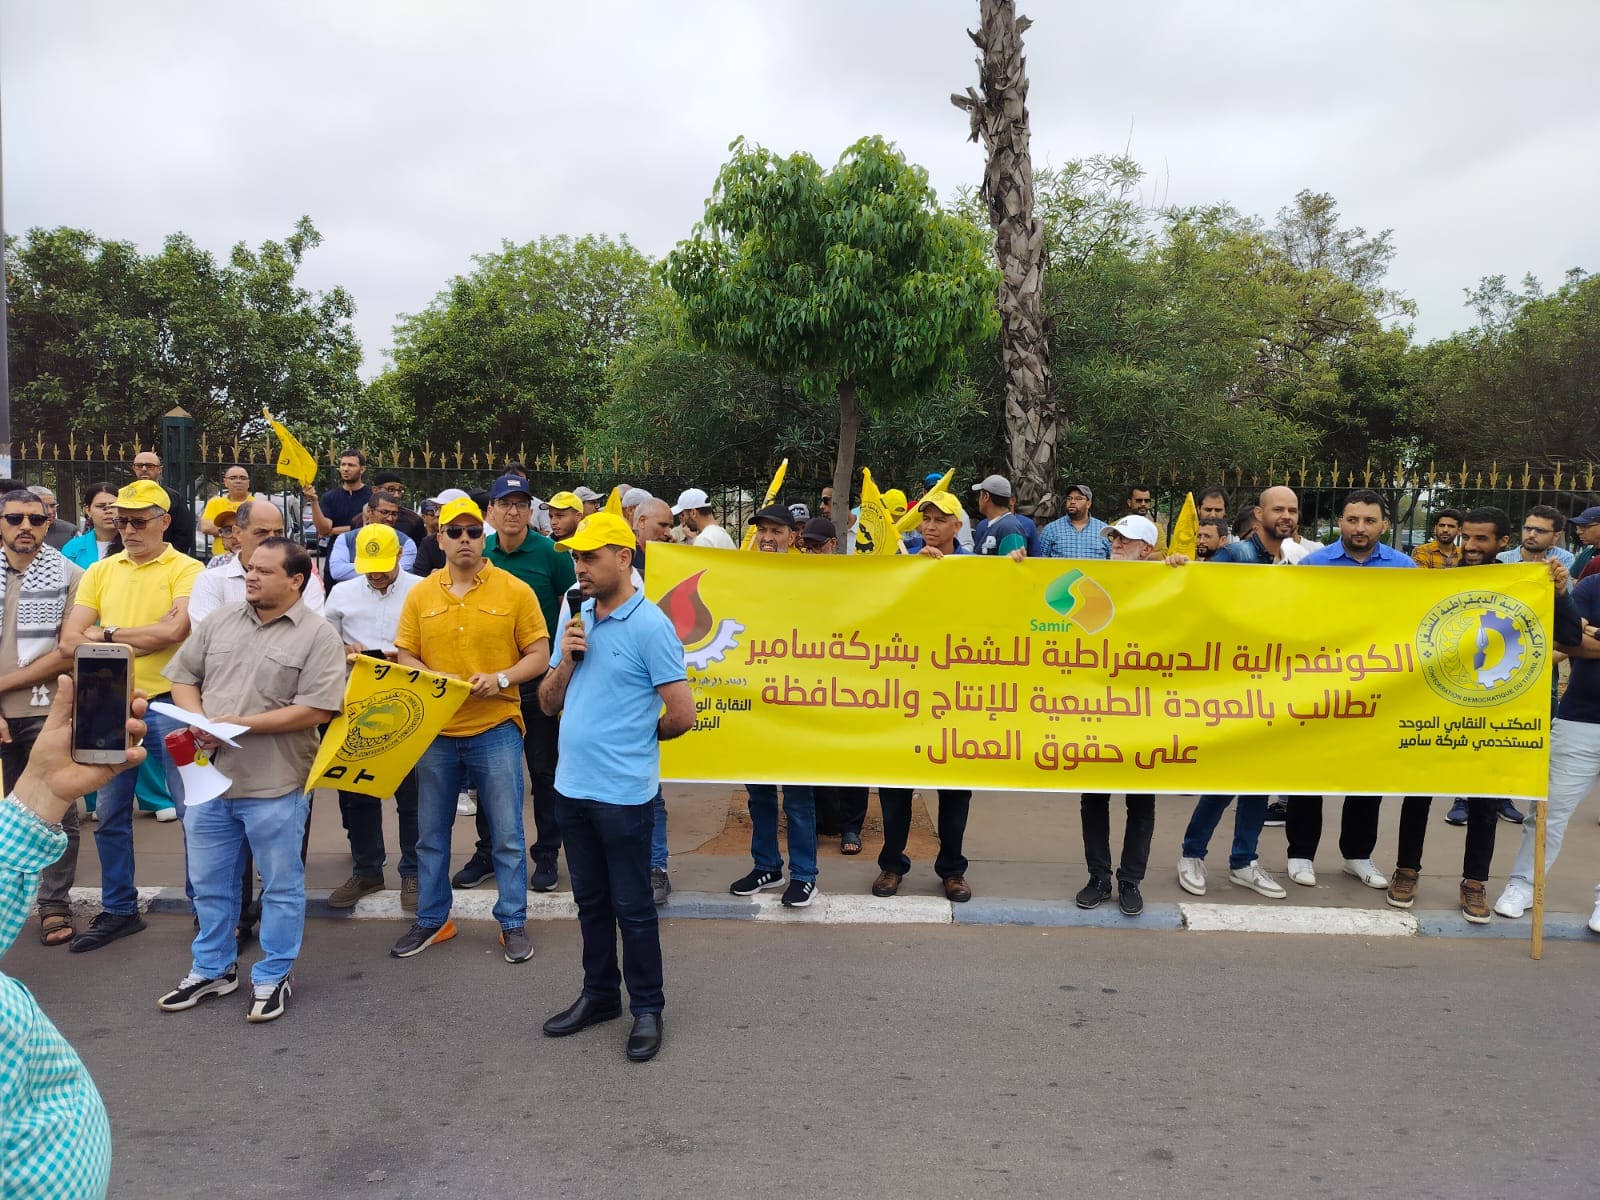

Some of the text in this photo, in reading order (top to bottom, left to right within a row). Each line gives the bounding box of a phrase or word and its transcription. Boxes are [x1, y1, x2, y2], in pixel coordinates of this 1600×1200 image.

[1030, 618, 1073, 633] Samir
[931, 633, 1031, 670] للشغل
[1042, 637, 1221, 678] الديمقراطية
[1232, 643, 1414, 682] الكونفدرالية
[715, 698, 752, 714] النقابة
[762, 675, 1382, 727] تطالب بالعودة الطبيعية للإنتاج والمحافظة
[1398, 716, 1542, 733] المكتب النقابي الموحد
[1398, 733, 1544, 751] لمستخدمي شركة سامير
[1034, 734, 1124, 770] حقوق
[1135, 734, 1199, 769] على
